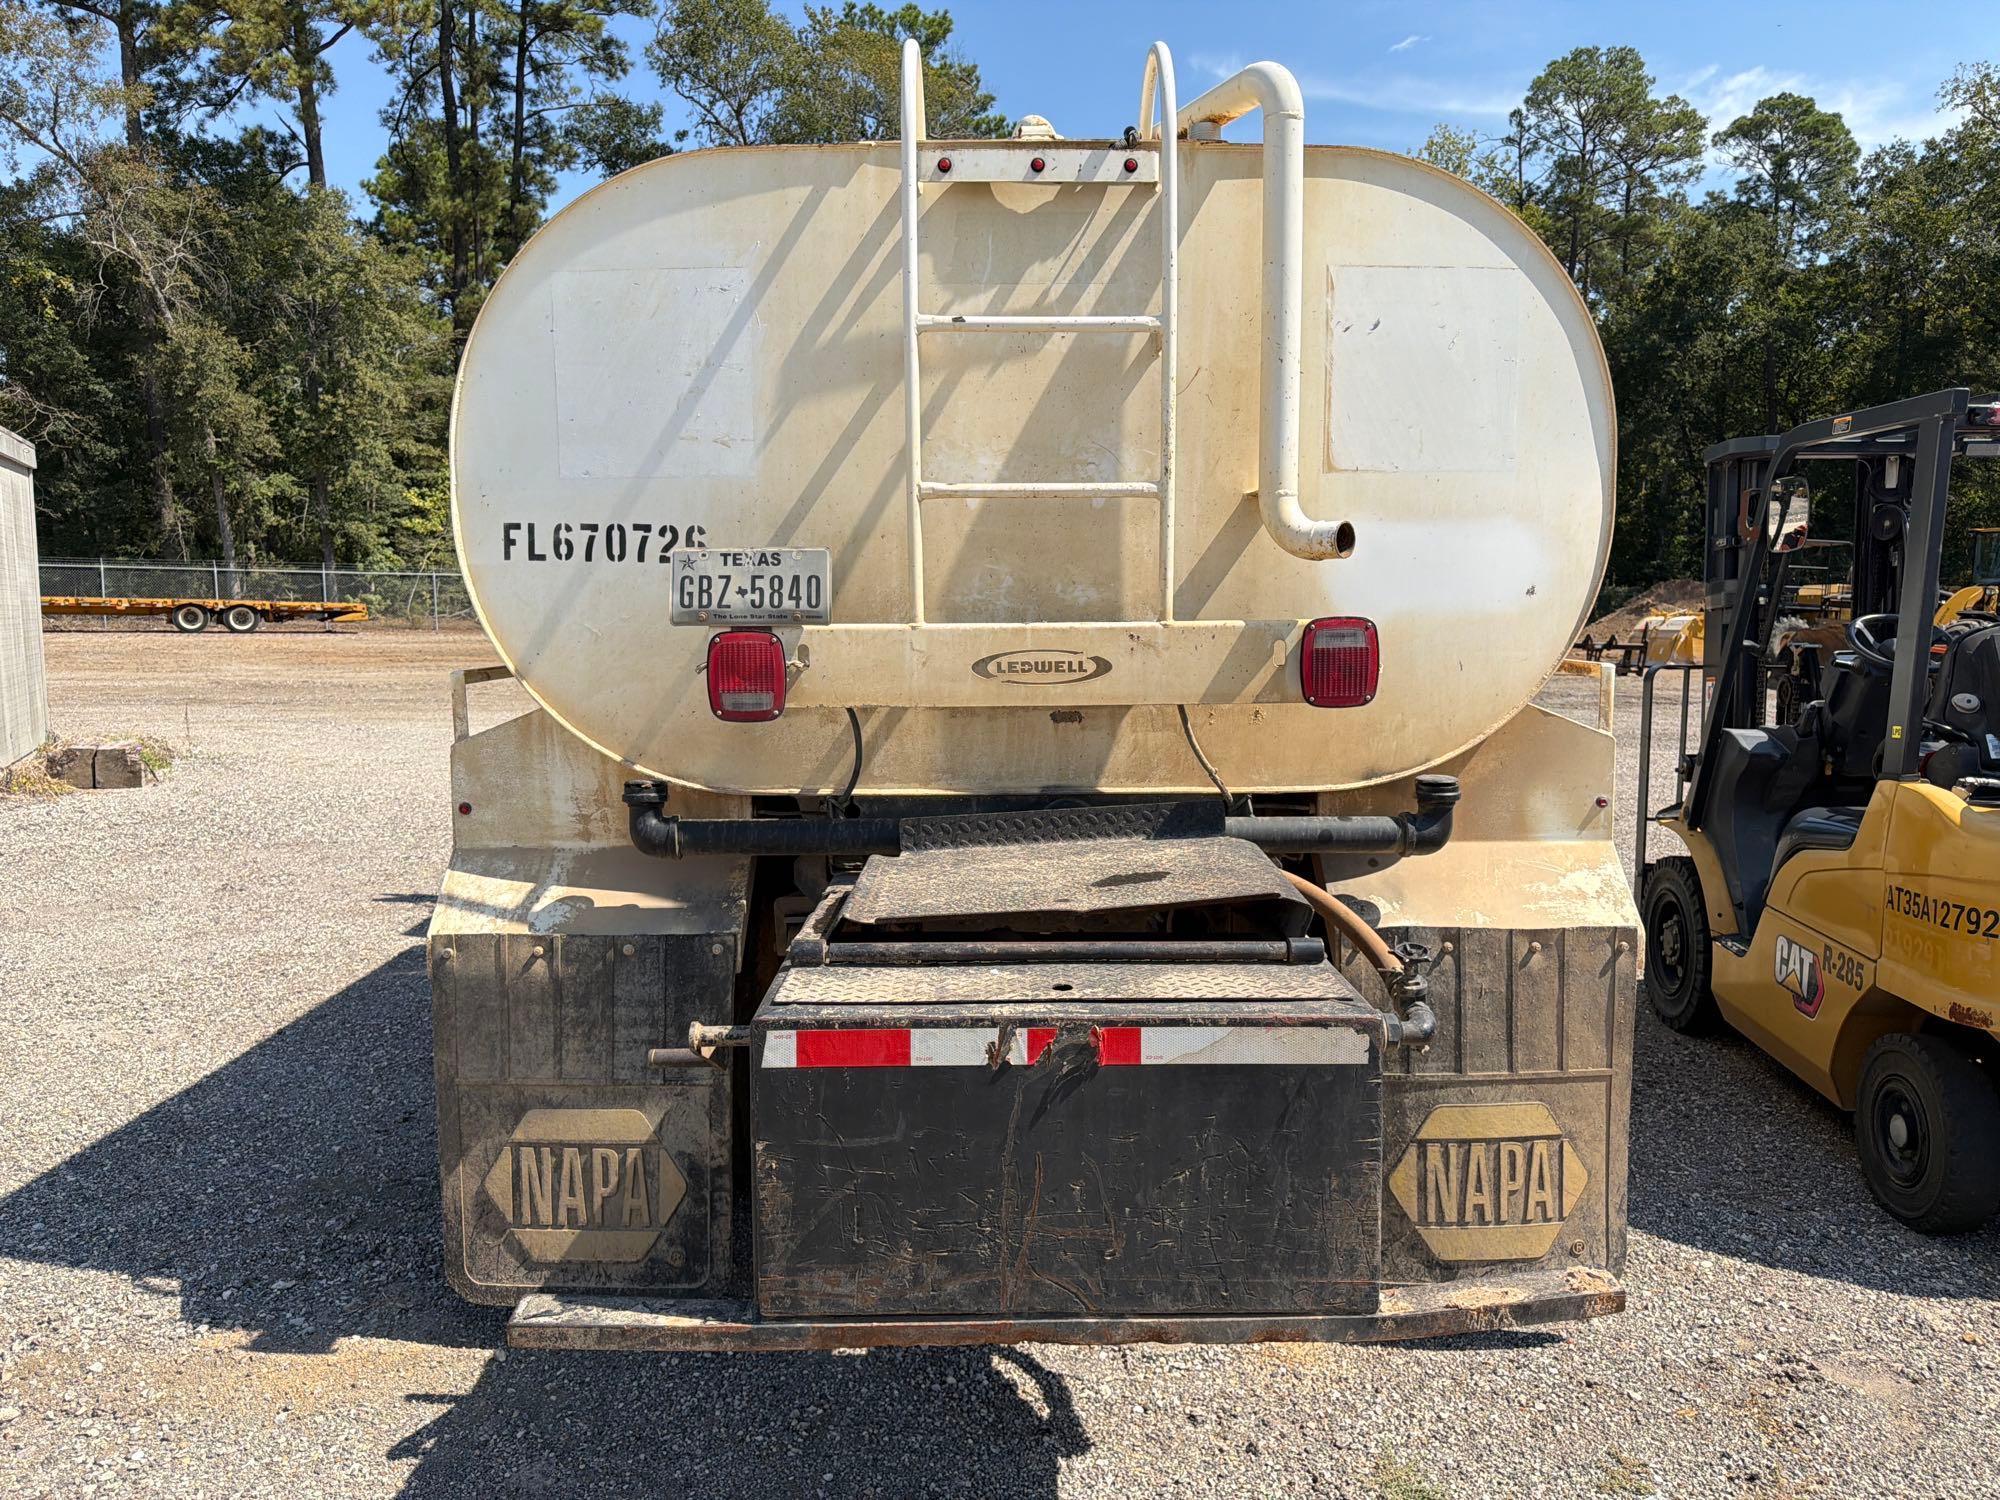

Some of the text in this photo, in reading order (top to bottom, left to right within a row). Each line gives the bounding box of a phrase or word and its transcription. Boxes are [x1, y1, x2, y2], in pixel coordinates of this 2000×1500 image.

[720, 552, 782, 567] TEXAS
[679, 575, 821, 609] GBZ 5840
[996, 660, 1088, 674] LEDWELL
[1886, 885, 2000, 939] AT35A12792
[1775, 935, 1814, 1000] CAT
[1822, 944, 1865, 992] R-285
[519, 1146, 651, 1227] NAPA
[1425, 1139, 1555, 1224] NAPA
